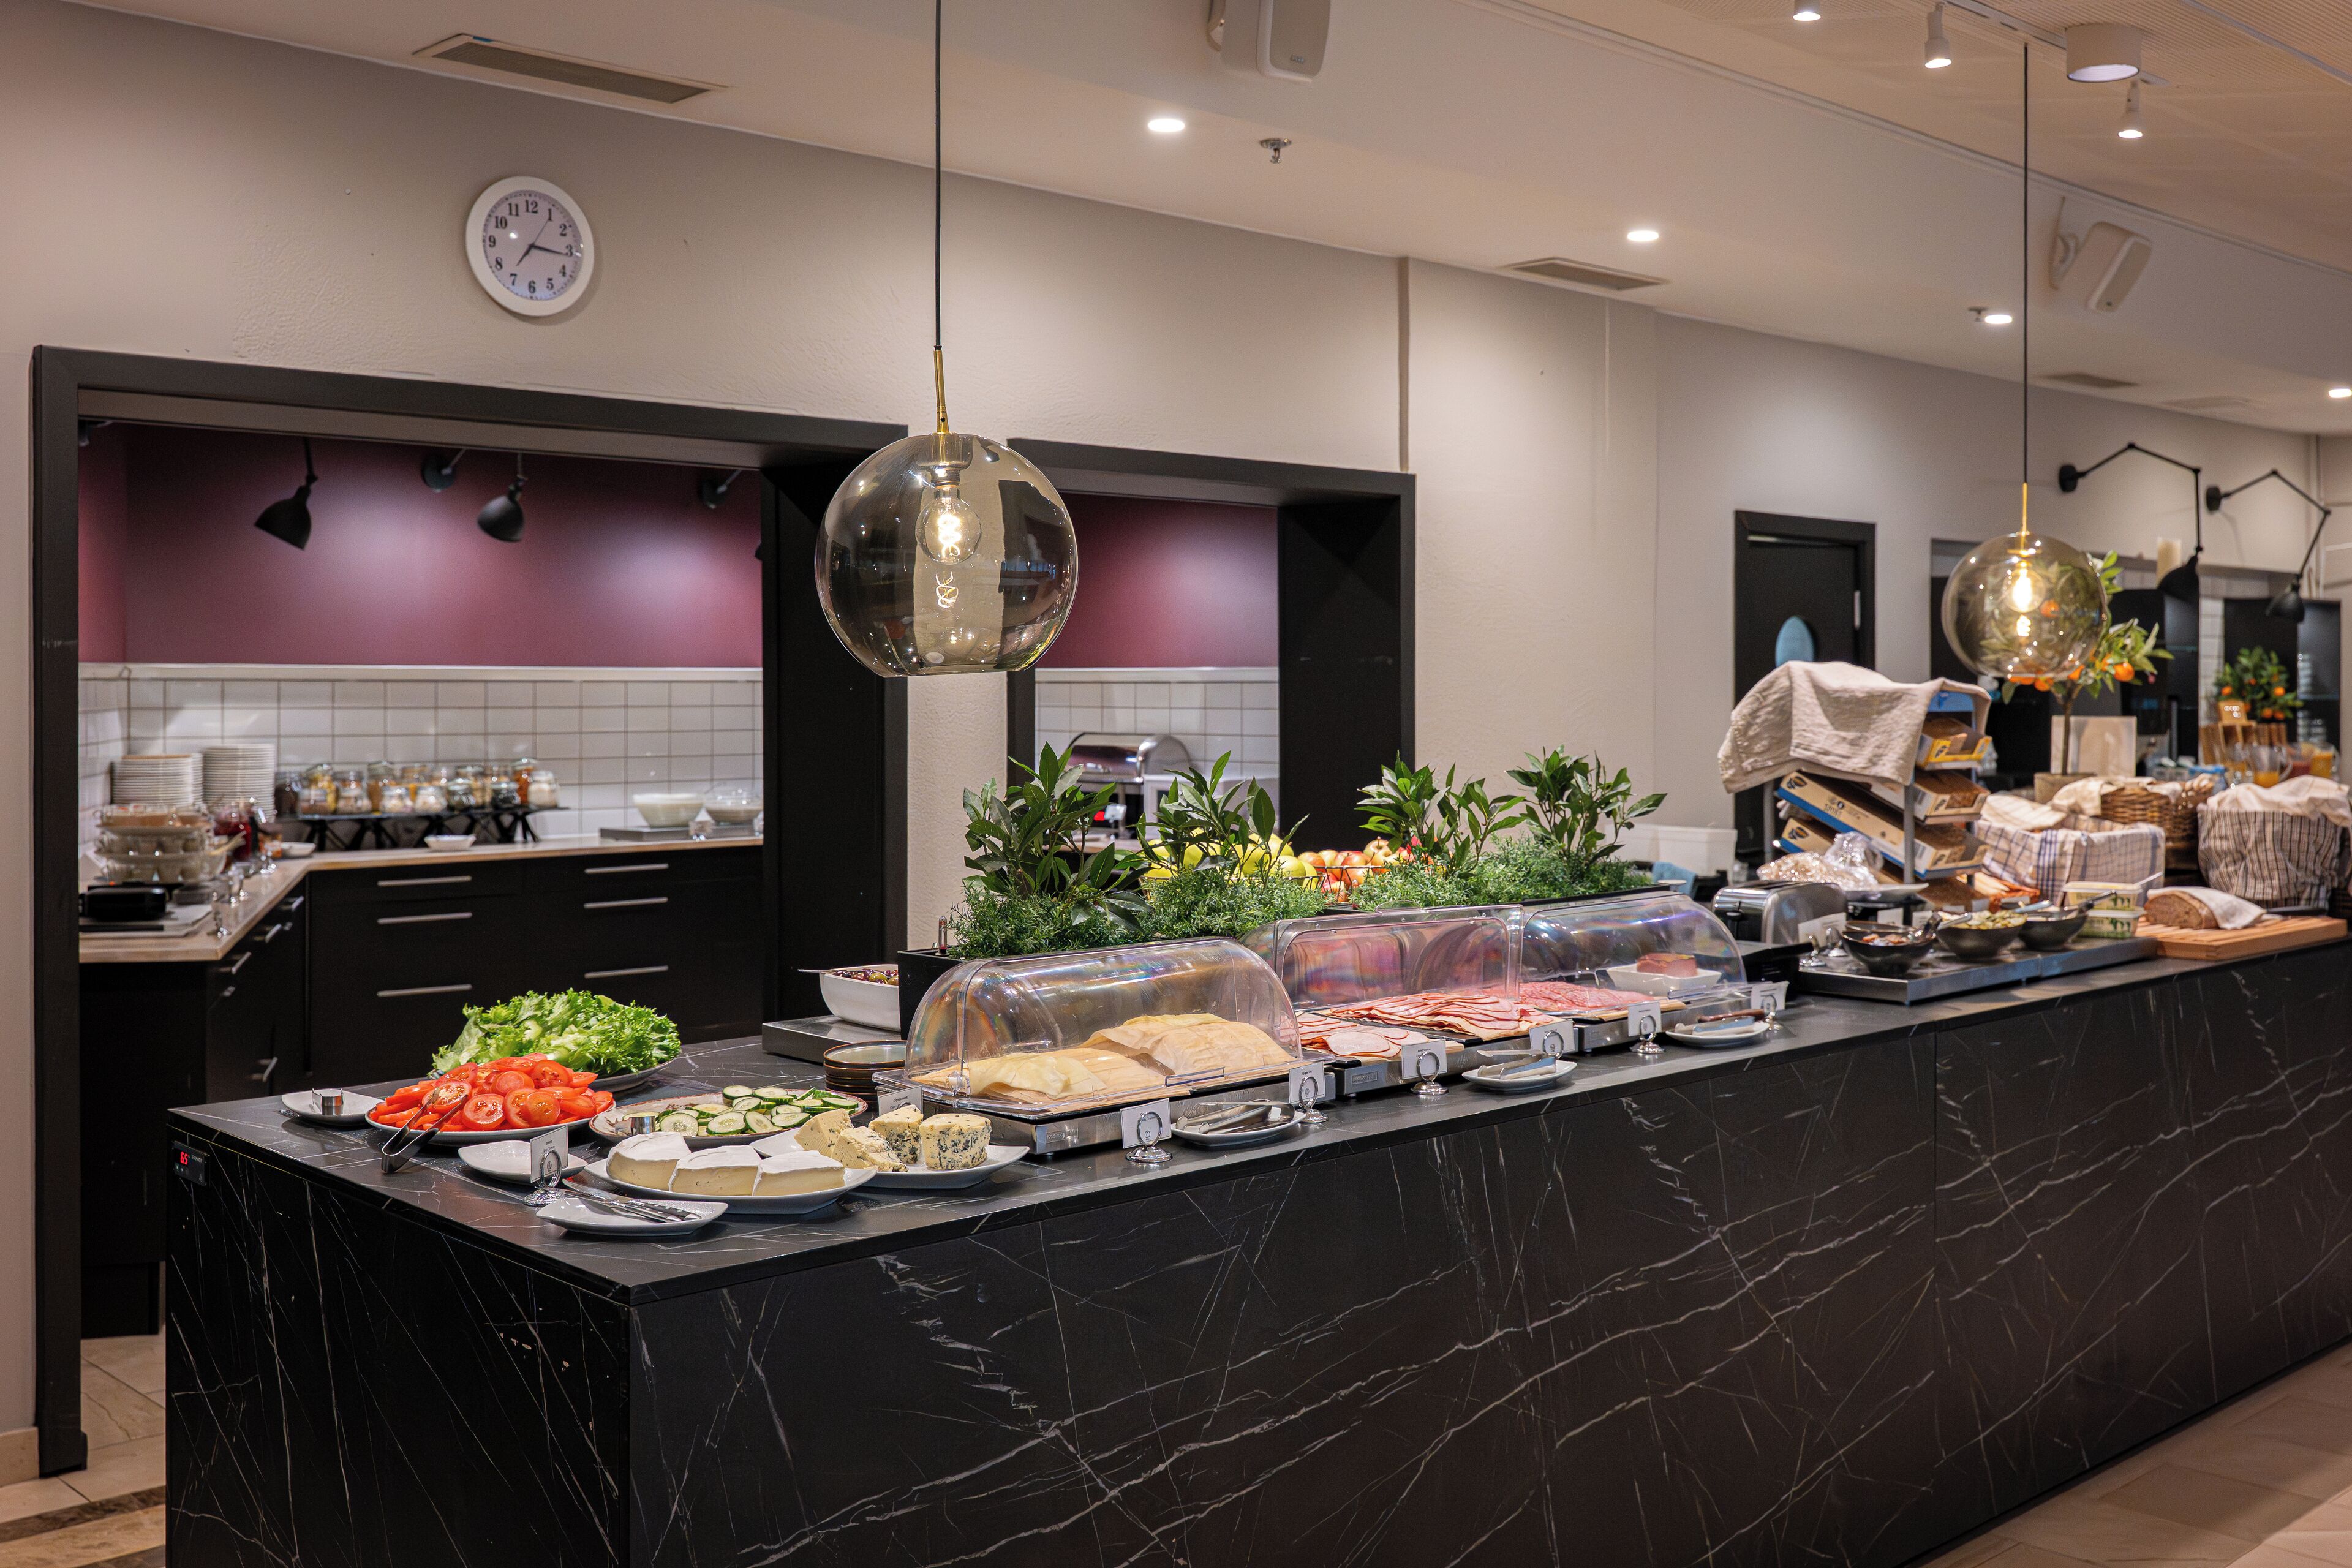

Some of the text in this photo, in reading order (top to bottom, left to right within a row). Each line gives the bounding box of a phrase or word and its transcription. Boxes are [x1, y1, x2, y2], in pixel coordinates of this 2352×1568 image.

[508, 203, 520, 217] 11
[524, 200, 539, 214] 12
[548, 208, 553, 222] 1
[494, 216, 508, 230] 10
[559, 223, 567, 238] 2
[488, 235, 496, 248] 9
[565, 244, 574, 258] 3
[495, 257, 503, 271] 8
[559, 264, 567, 277] 4
[510, 273, 518, 286] 7
[528, 280, 536, 293] 6
[546, 278, 554, 291] 5
